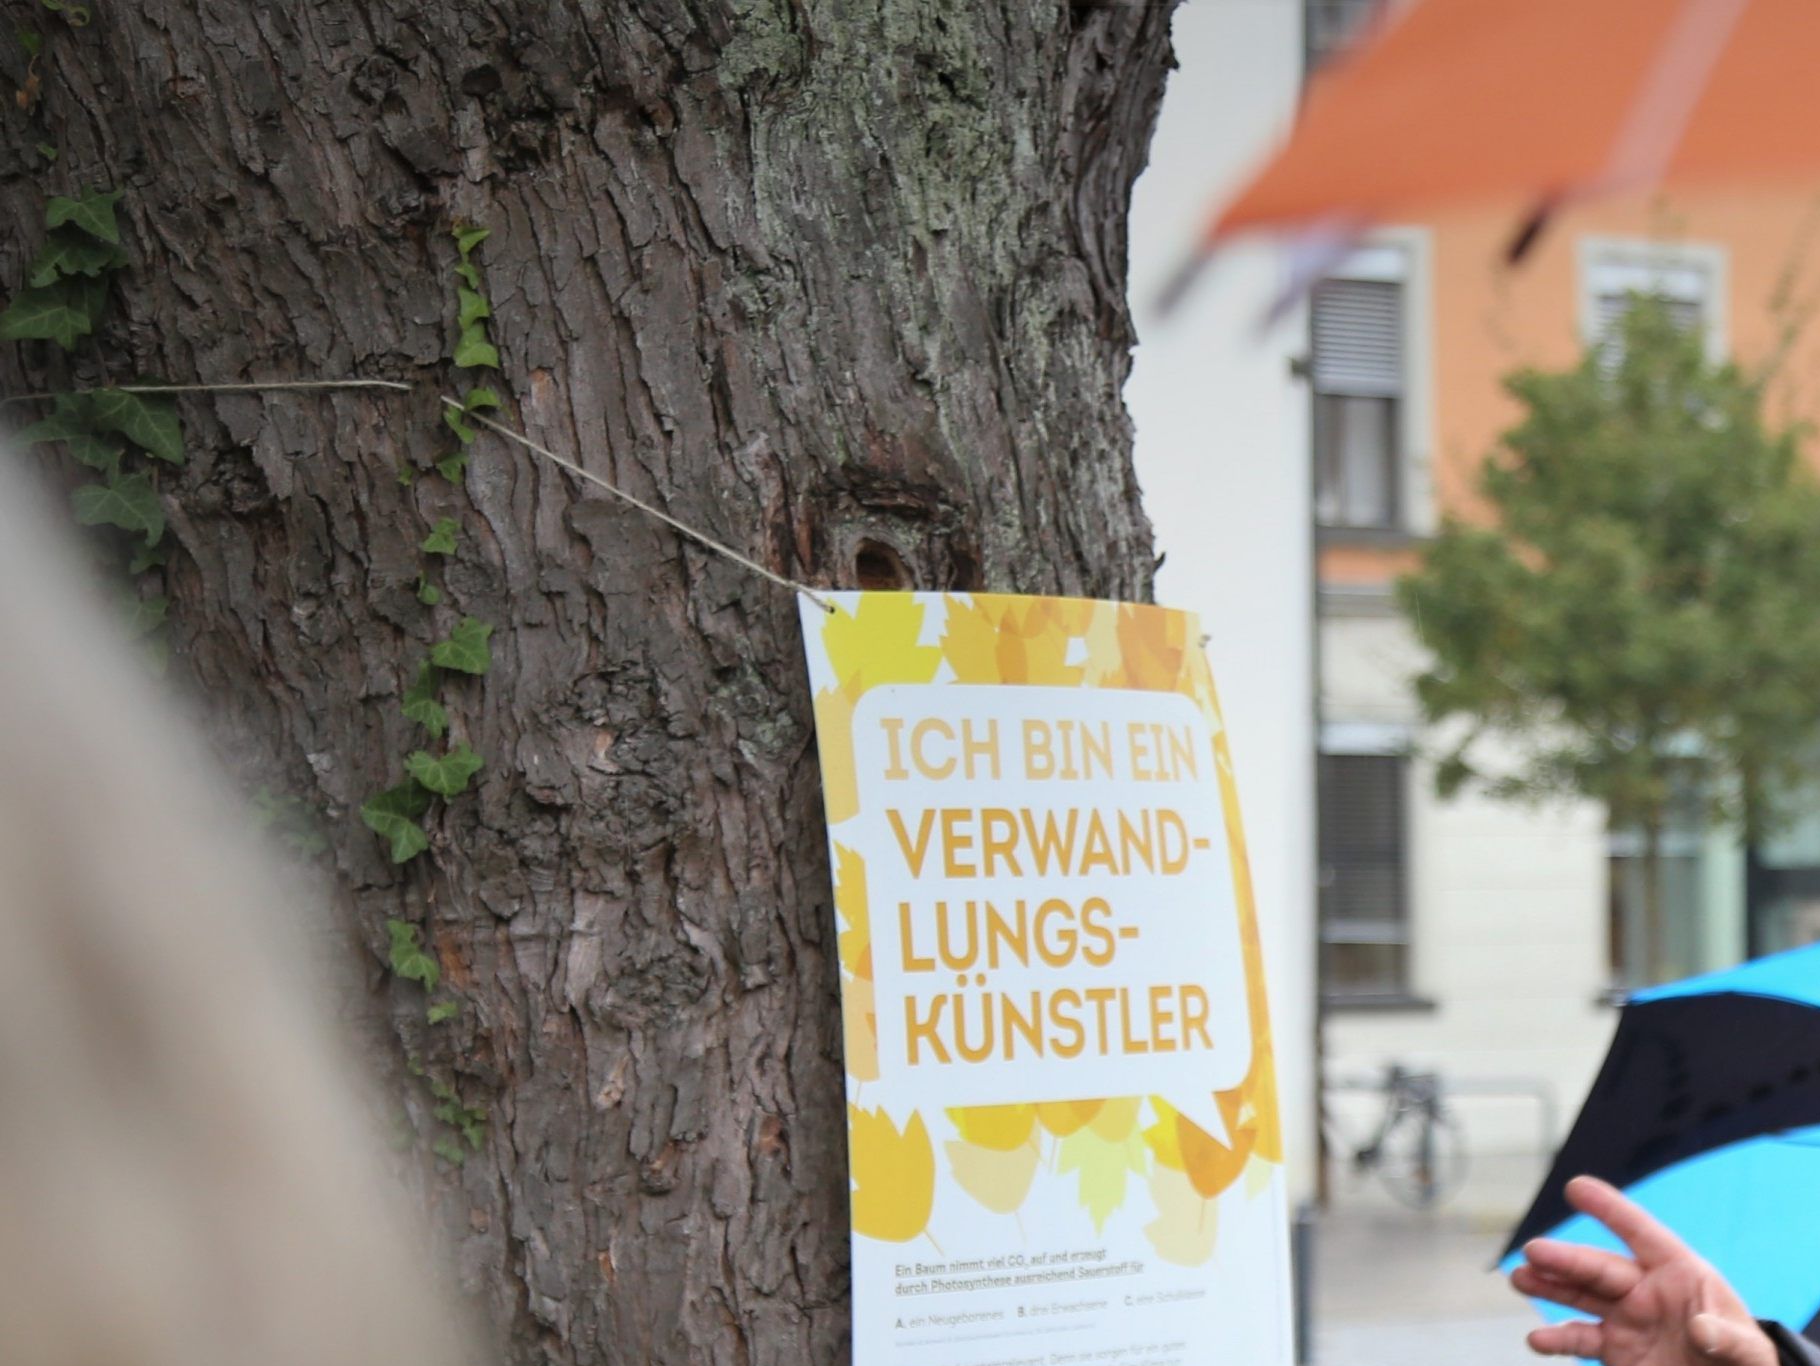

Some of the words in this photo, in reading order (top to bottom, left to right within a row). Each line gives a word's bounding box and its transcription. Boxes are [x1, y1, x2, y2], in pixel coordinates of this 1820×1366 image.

[880, 718, 1000, 780] ICH
[1022, 720, 1113, 780] BIN
[1131, 722, 1199, 781] EIN
[886, 807, 1211, 878] VERWAND-
[899, 897, 1139, 973] LUNGS-
[905, 973, 1213, 1065] KÜNSTLER
[895, 1265, 912, 1276] Ein
[916, 1263, 946, 1275] Baum
[949, 1259, 983, 1272] nimmt
[987, 1256, 1005, 1269] viel
[1030, 1253, 1047, 1265] auf
[1050, 1251, 1068, 1263] und
[1070, 1248, 1106, 1262] erzeugt
[895, 1281, 926, 1295] durch
[931, 1275, 1011, 1292] Photosynthese
[1014, 1270, 1075, 1283] ausreichend
[1079, 1263, 1128, 1278] Sauerstoff
